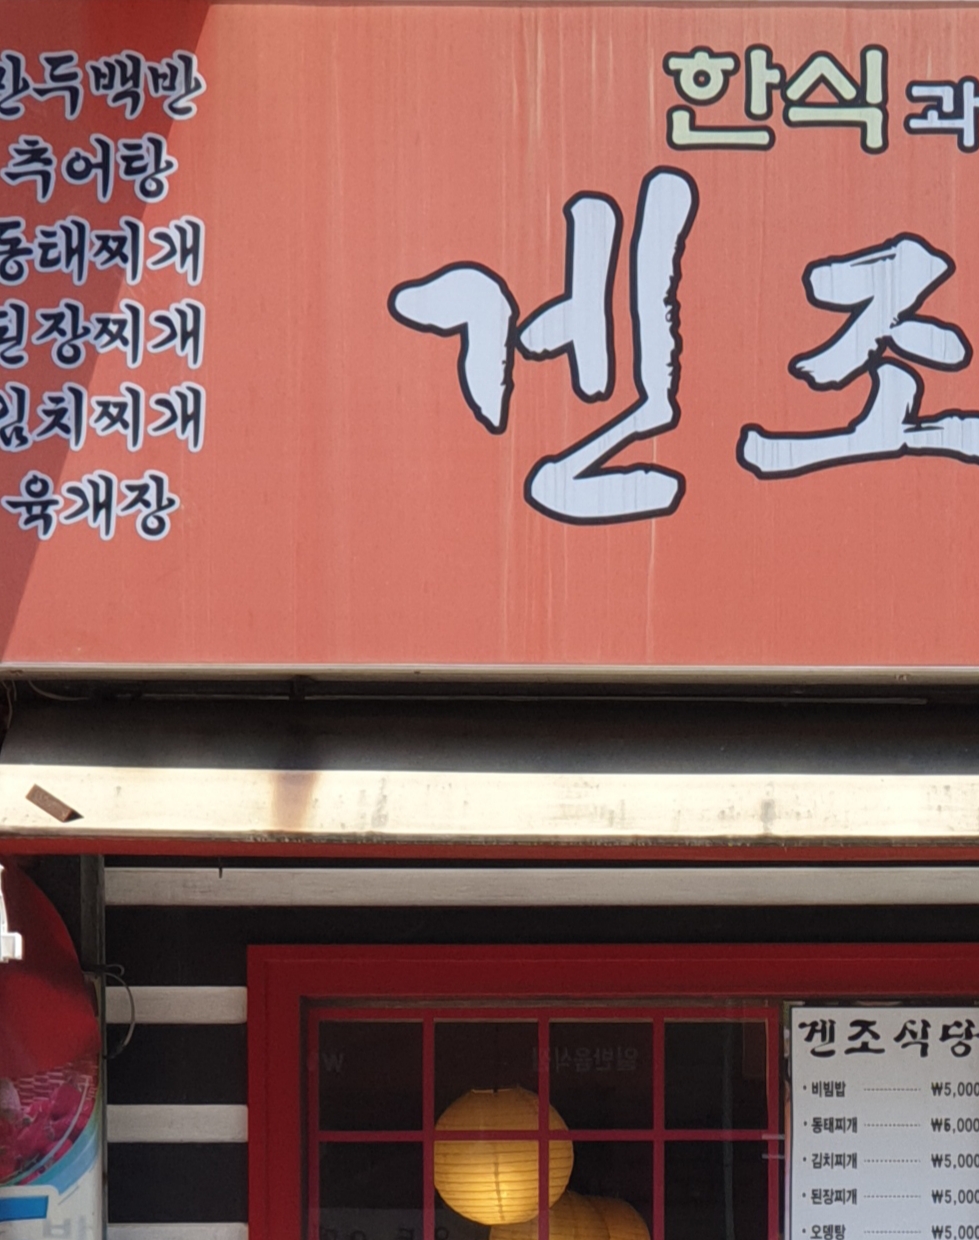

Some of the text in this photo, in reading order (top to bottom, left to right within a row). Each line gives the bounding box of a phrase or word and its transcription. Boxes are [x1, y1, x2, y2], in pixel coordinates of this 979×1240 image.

[2, 133, 177, 202] 추어탕
[0, 215, 205, 285] 동태찌개
[3, 469, 180, 541] 육개장
[811, 1080, 847, 1098] 비빔밥
[810, 1116, 858, 1134] 동태찌개
[811, 1152, 858, 1170] 김치찌개
[810, 1188, 858, 1206] 된장찌개
